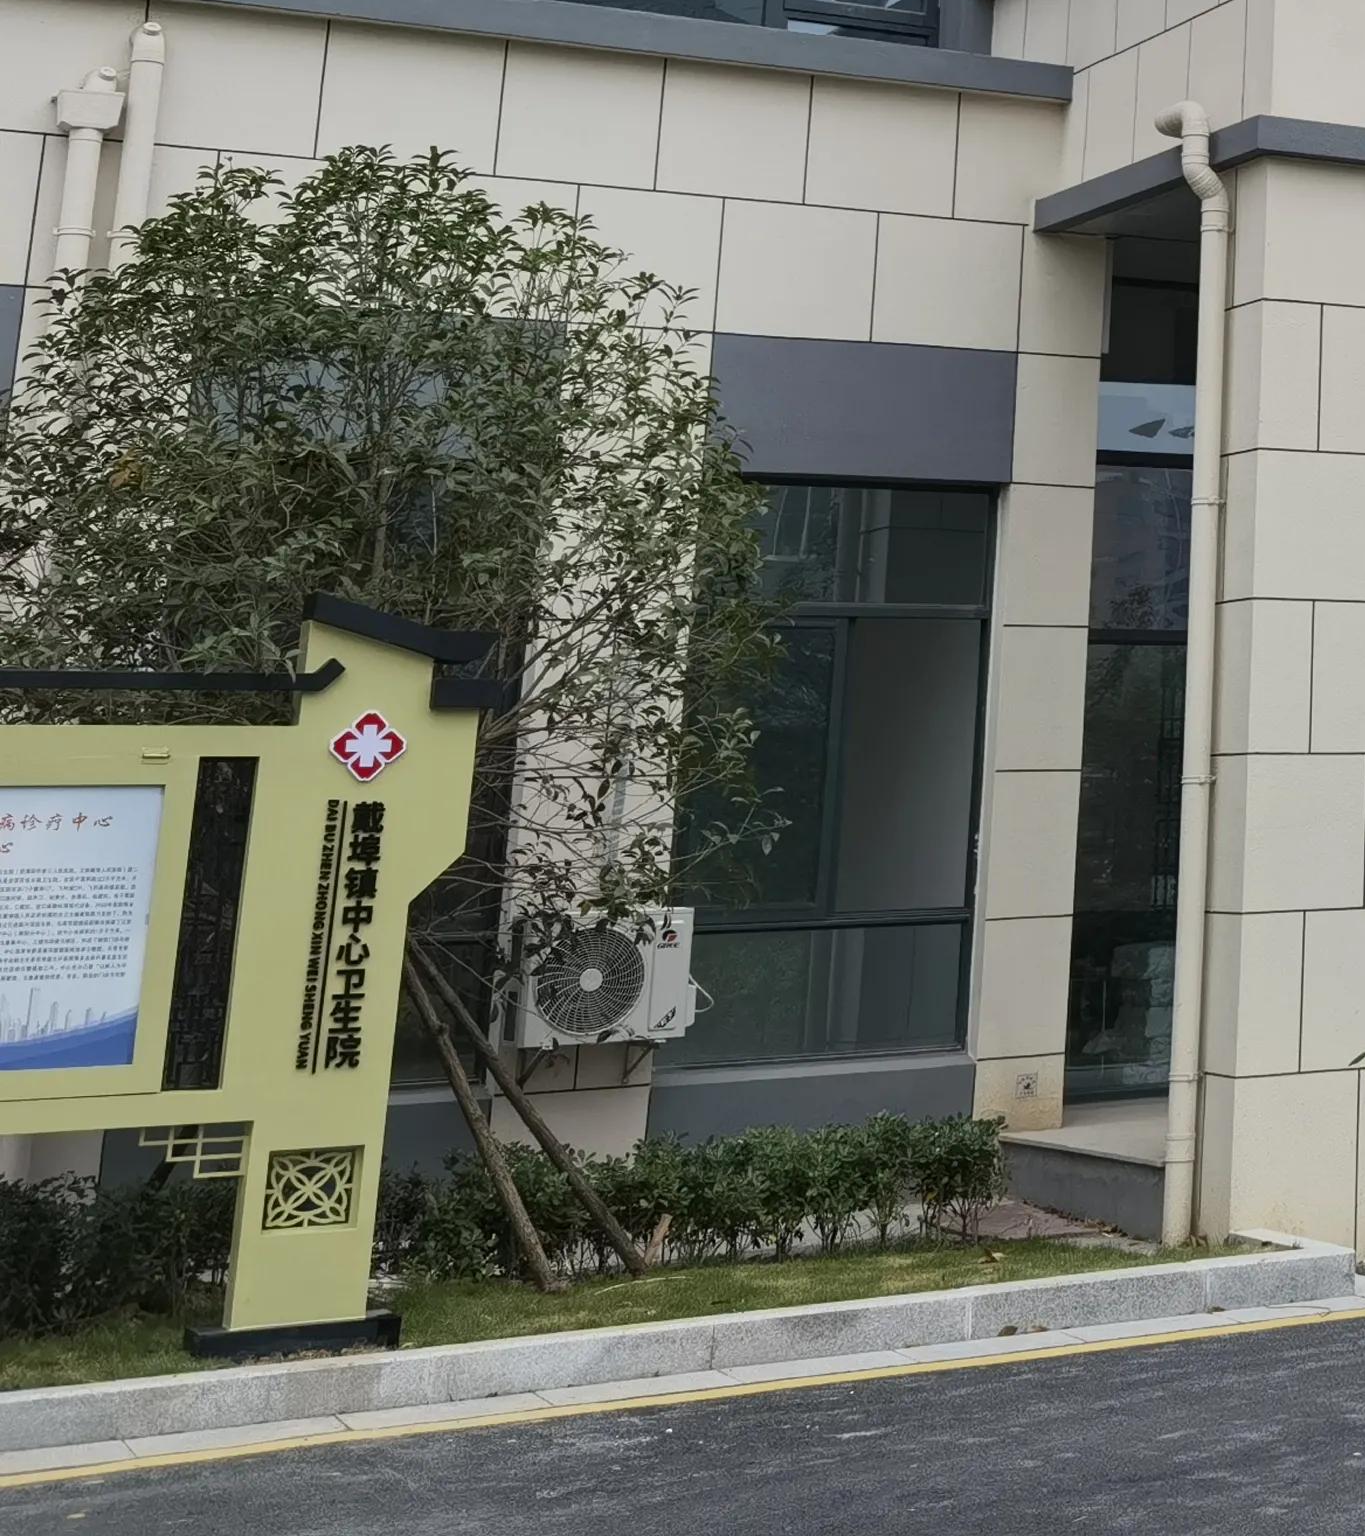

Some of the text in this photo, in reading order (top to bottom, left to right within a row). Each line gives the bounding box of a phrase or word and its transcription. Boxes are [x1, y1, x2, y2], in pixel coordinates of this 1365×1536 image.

[295, 799, 340, 1069] DAI BU ZHEN ZHONG XIN WEI SHENG YUAN
[324, 801, 386, 1069] 戴埠镇中心卫生院
